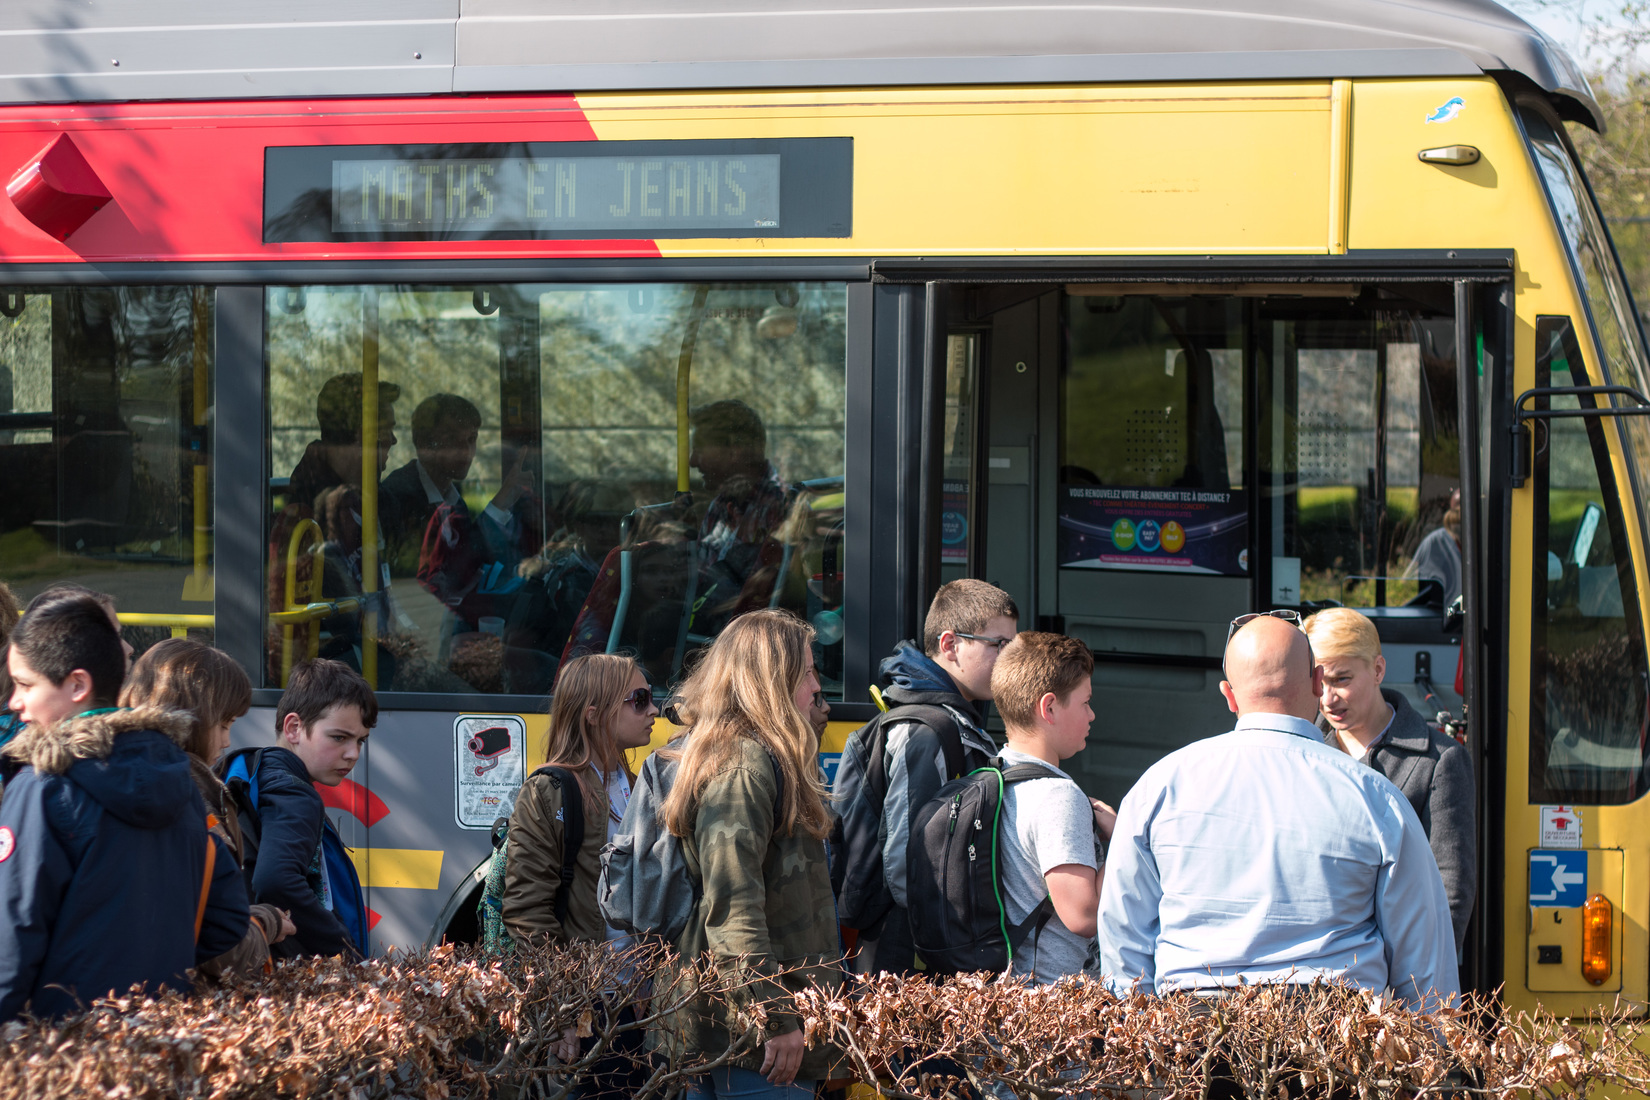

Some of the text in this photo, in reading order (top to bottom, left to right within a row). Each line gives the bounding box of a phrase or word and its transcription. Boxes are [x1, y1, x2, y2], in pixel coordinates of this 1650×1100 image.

[361, 161, 748, 220] MATHS EN JEANS
[1069, 487, 1231, 503] VOUS RENOUVELEZ VOTRE ABONNEMENT TEC À DISTANCE ?
[483, 796, 499, 805] TEC
